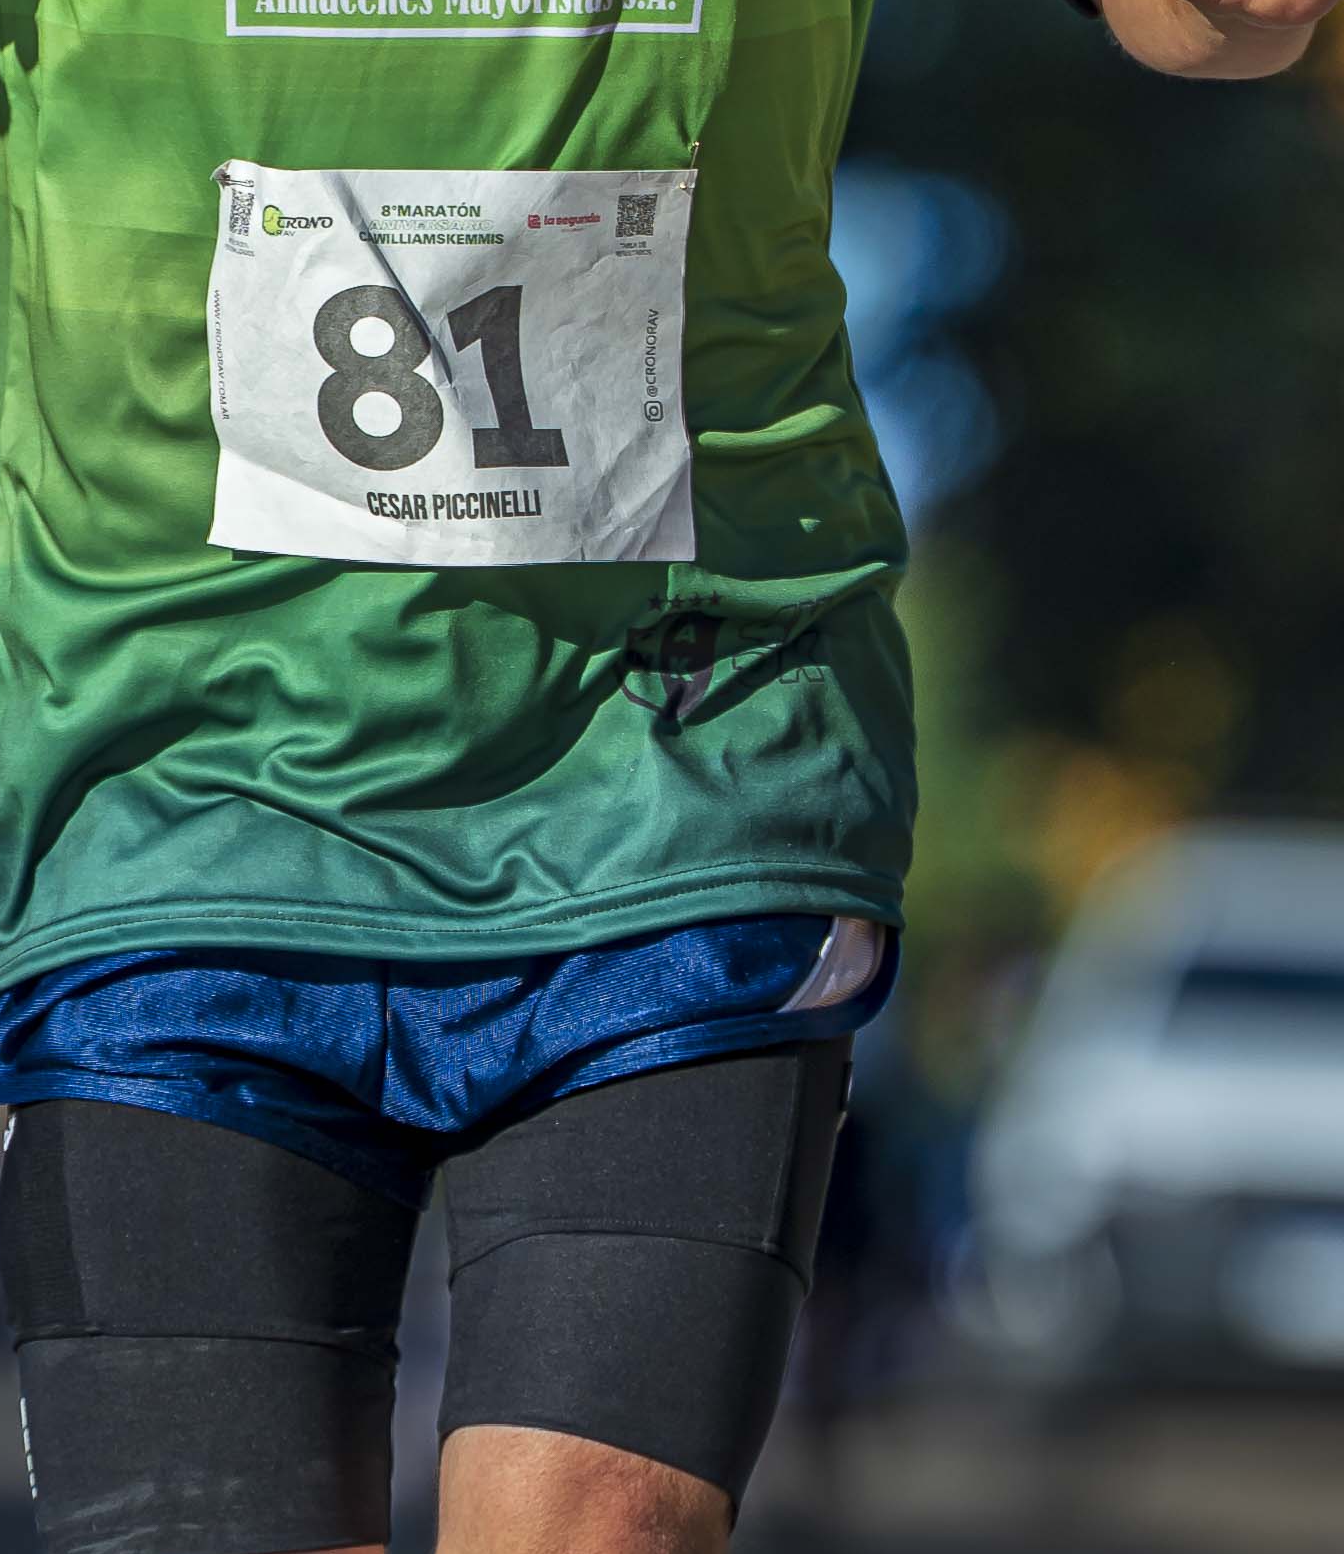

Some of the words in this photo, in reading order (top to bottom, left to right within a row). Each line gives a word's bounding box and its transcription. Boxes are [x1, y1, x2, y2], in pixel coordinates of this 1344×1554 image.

[276, 216, 334, 229] CRONO
[312, 284, 570, 472] 81
[645, 308, 659, 397] @CRONORAV
[366, 491, 428, 520] CESAR
[432, 489, 542, 520] PICCINELLI
